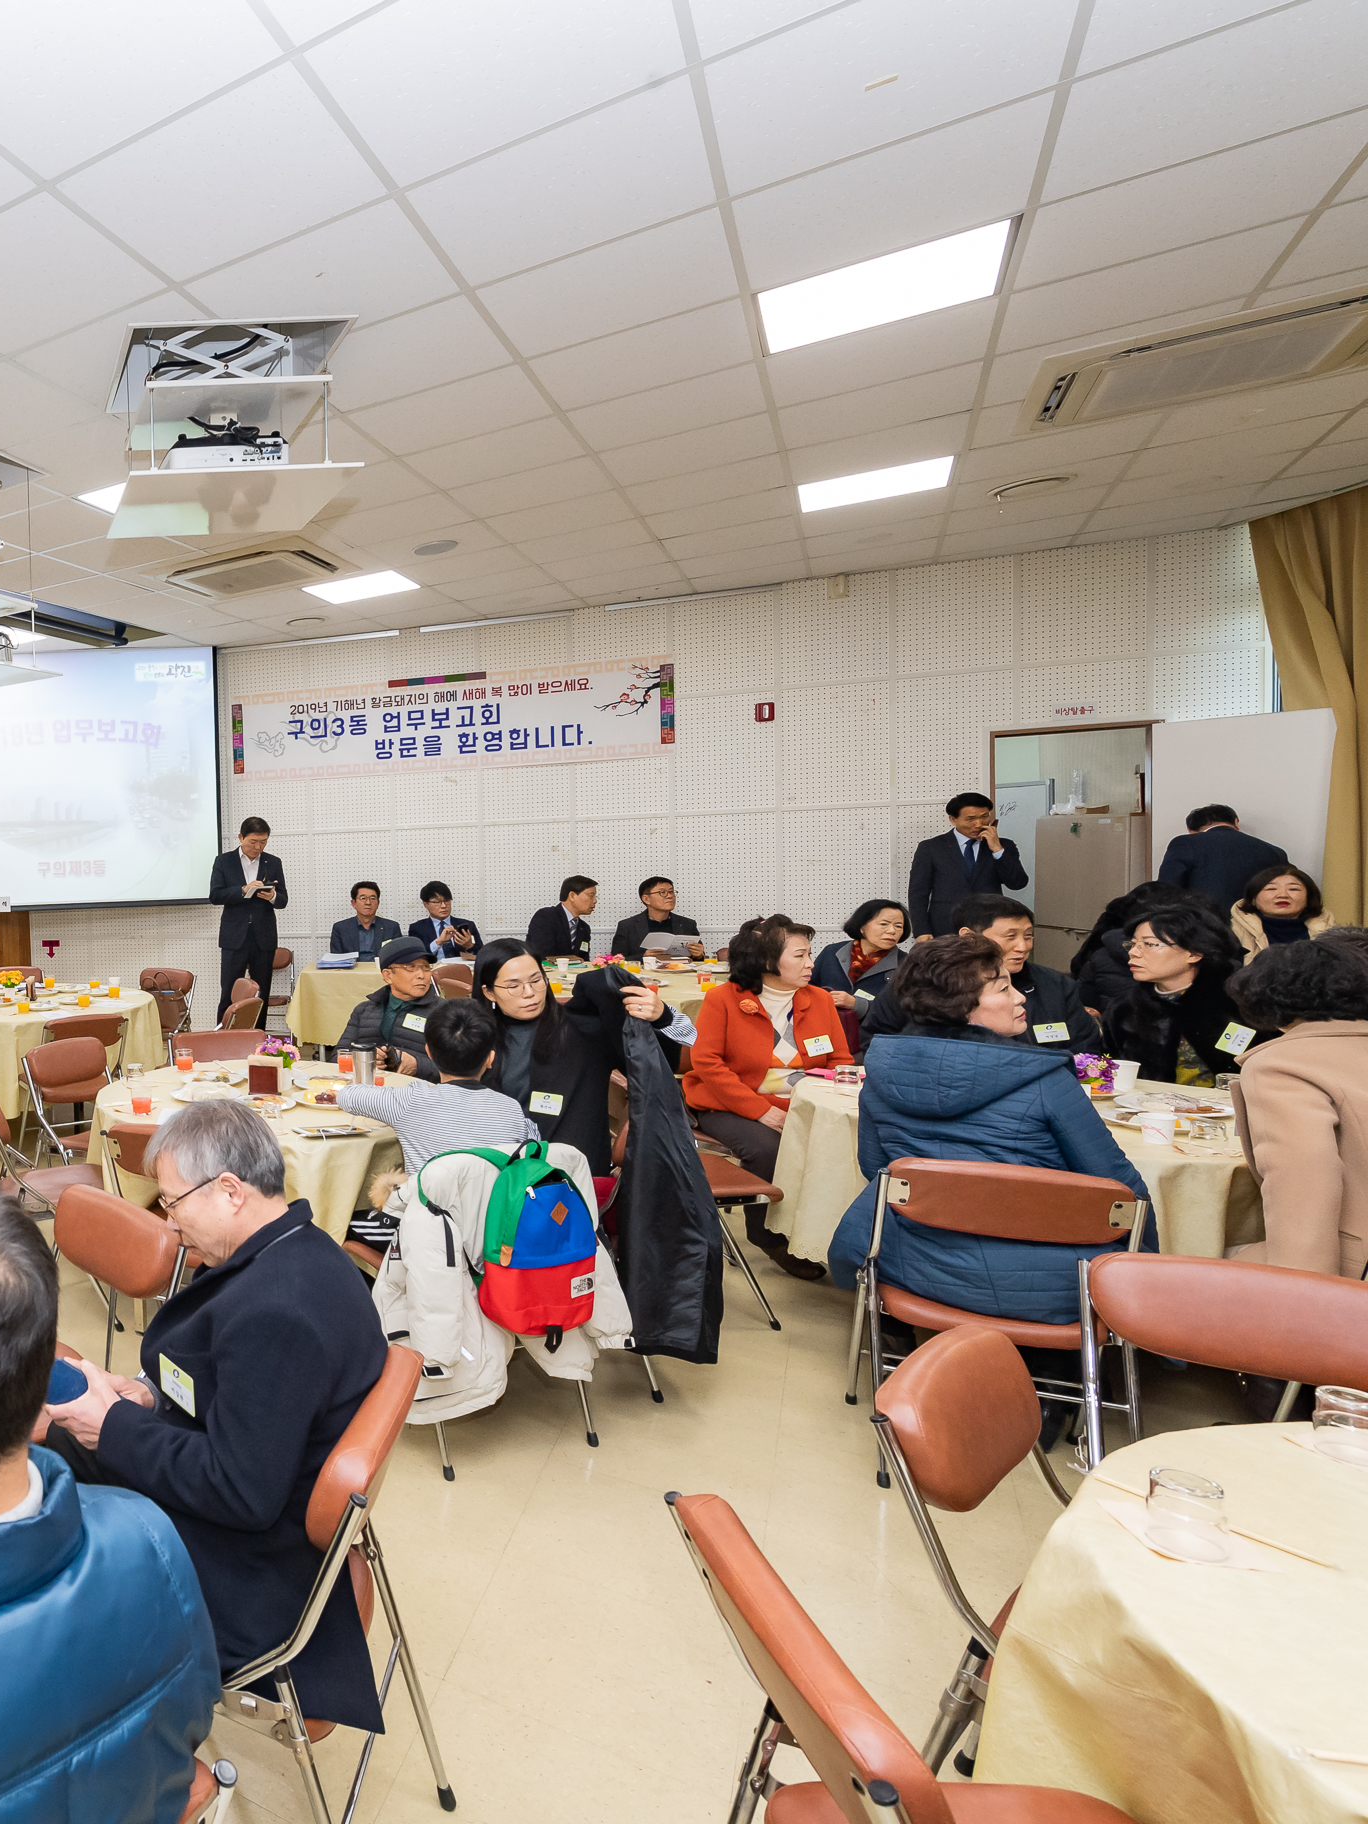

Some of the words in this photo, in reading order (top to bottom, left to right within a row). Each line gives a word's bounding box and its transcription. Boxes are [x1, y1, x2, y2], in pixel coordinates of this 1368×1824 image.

[289, 701, 328, 716] 2019년
[333, 698, 366, 712] 기해년
[371, 693, 429, 708] 황금돼지의
[433, 690, 458, 703] 해에
[462, 687, 487, 701] 새해
[491, 685, 503, 698] 복
[508, 683, 533, 697] 많이
[537, 678, 593, 695] 받으세요.
[1055, 705, 1095, 716] 비상탈출구
[52, 718, 162, 750] 업무보고회
[287, 714, 368, 740] 구의3동
[382, 703, 501, 734] 업무보고회
[374, 734, 443, 760] 방문을
[457, 723, 593, 755] 환영합니다.
[37, 860, 107, 878] 구의제3동
